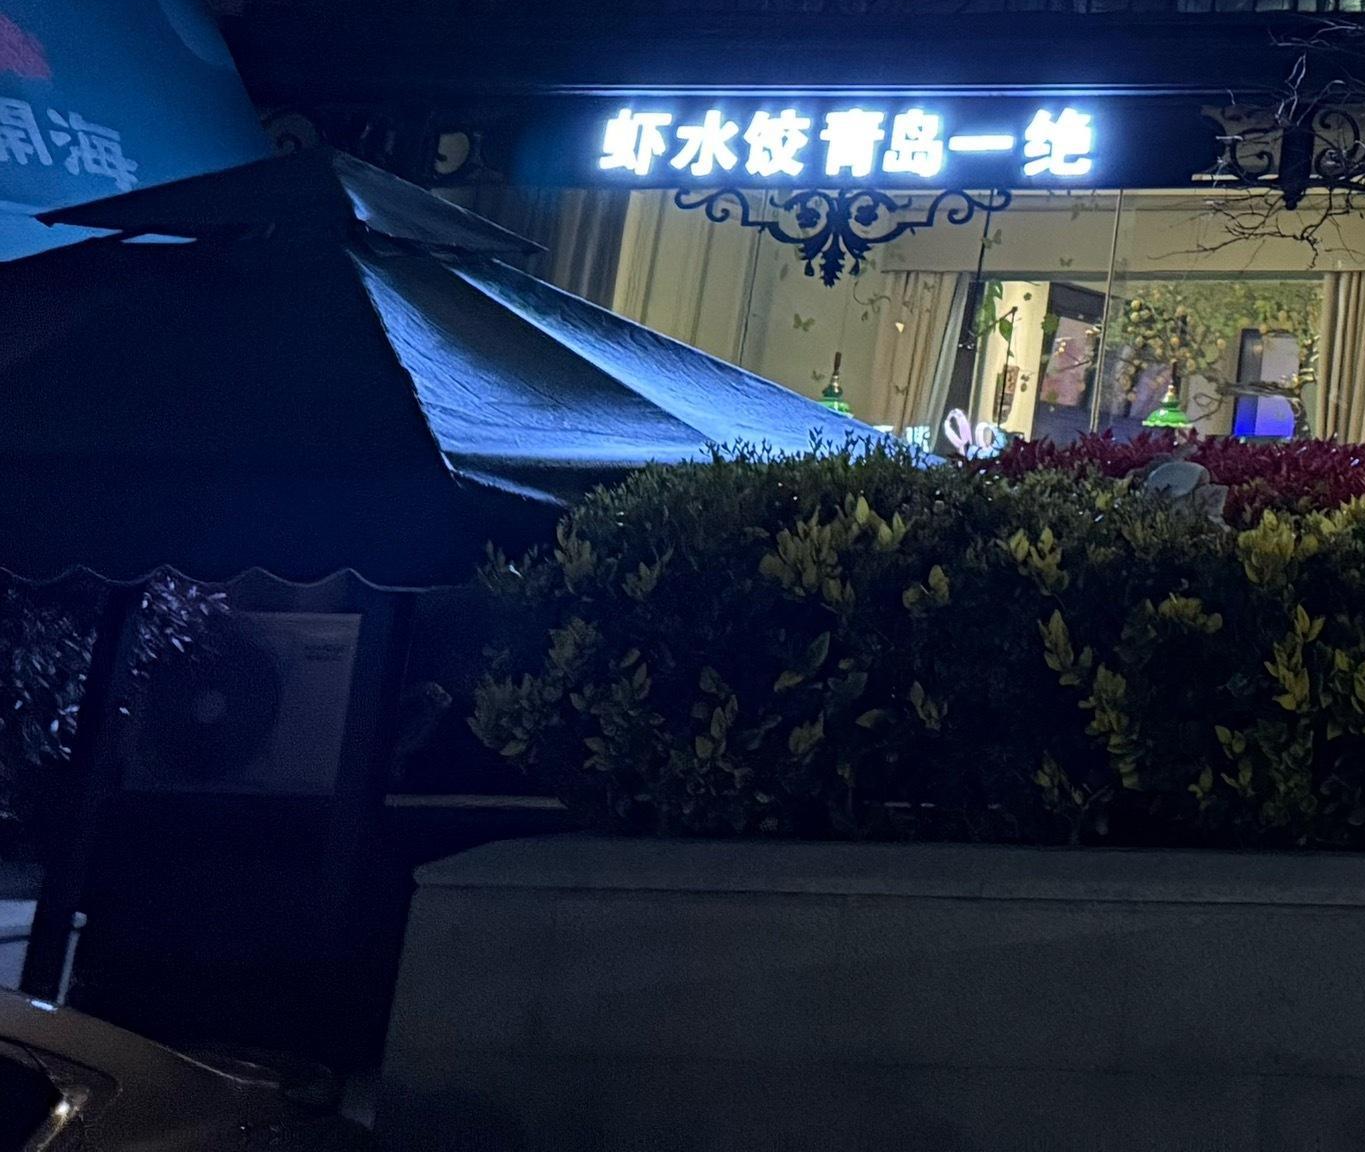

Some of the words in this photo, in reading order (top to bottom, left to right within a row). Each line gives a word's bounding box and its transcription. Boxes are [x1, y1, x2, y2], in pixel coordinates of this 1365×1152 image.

[599, 107, 1094, 177] 虾水饺青岛一绝
